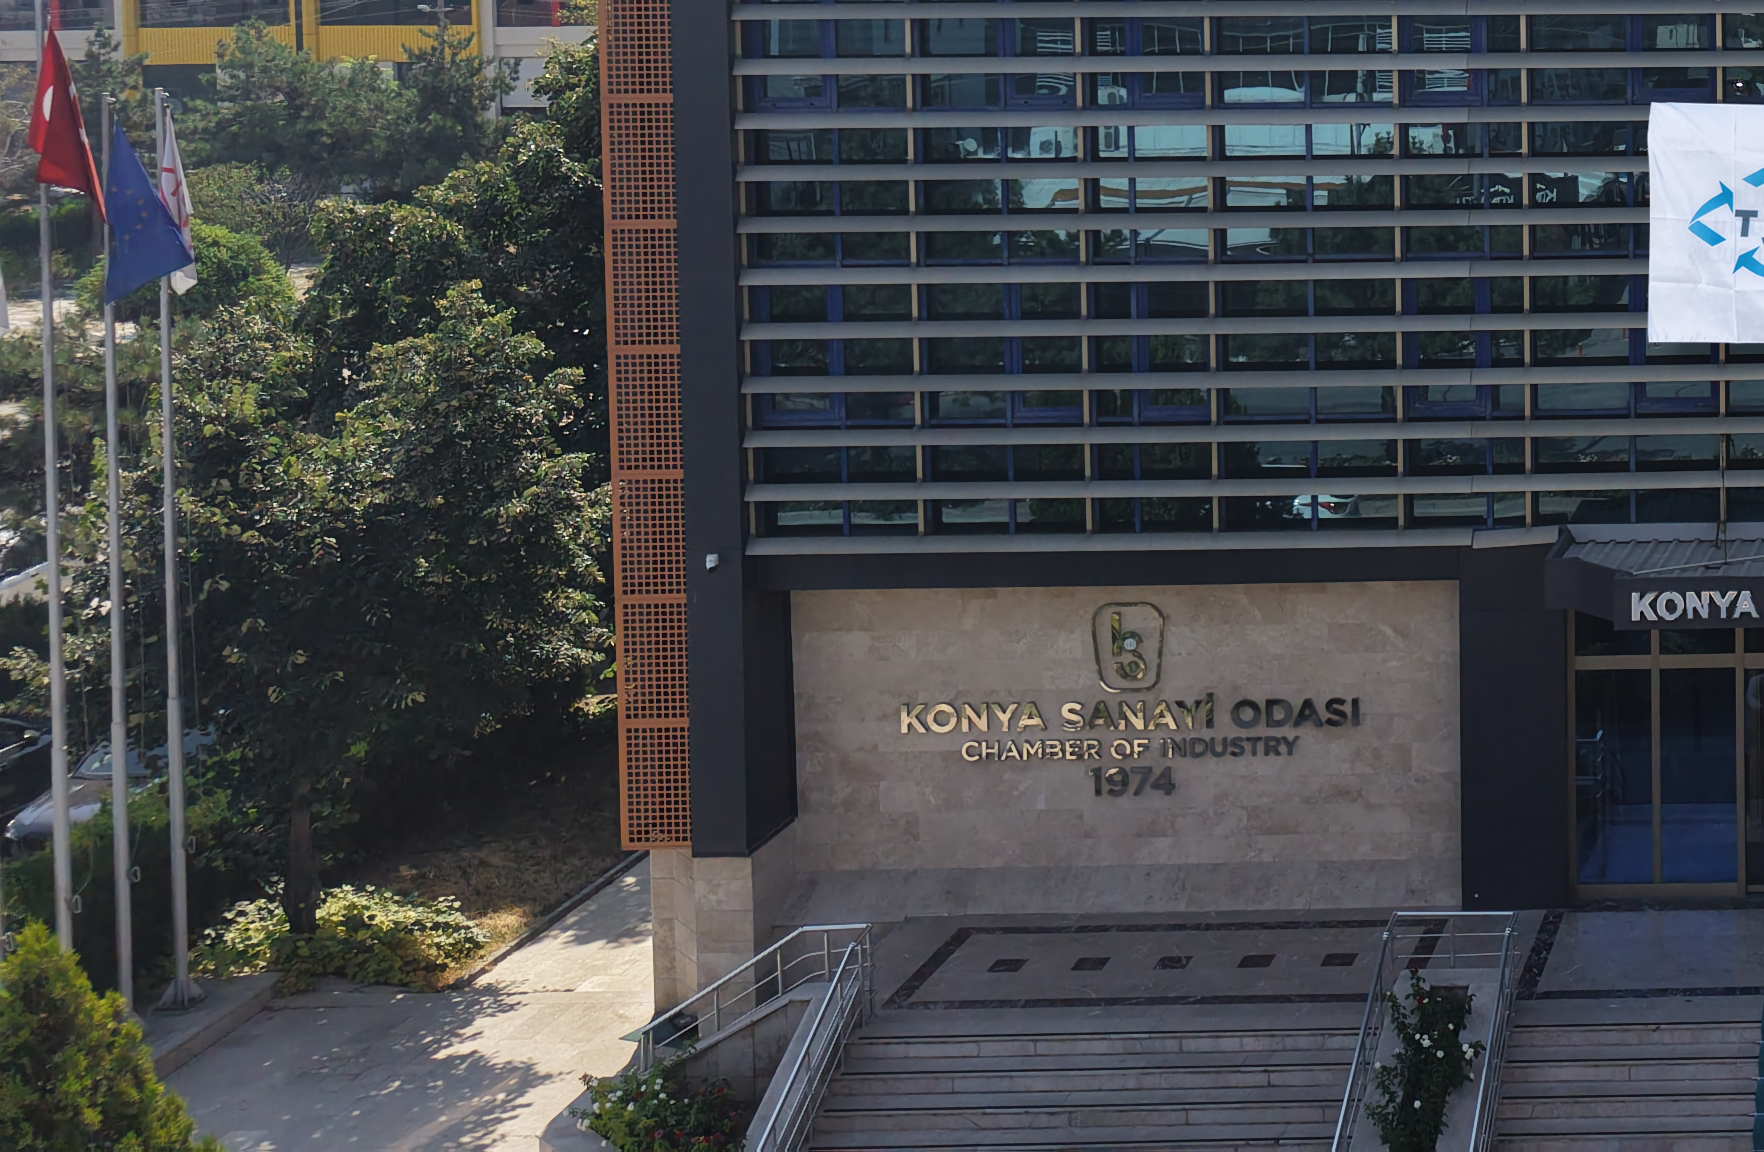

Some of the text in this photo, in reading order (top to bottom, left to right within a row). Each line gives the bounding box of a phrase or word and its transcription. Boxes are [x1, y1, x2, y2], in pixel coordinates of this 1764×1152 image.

[1631, 590, 1760, 622] KONYA
[900, 692, 1361, 735] KONYA SANAYİ ODASI
[961, 735, 1301, 762] CHAMBER OF INDUSTRY
[1087, 765, 1177, 798] 1974
